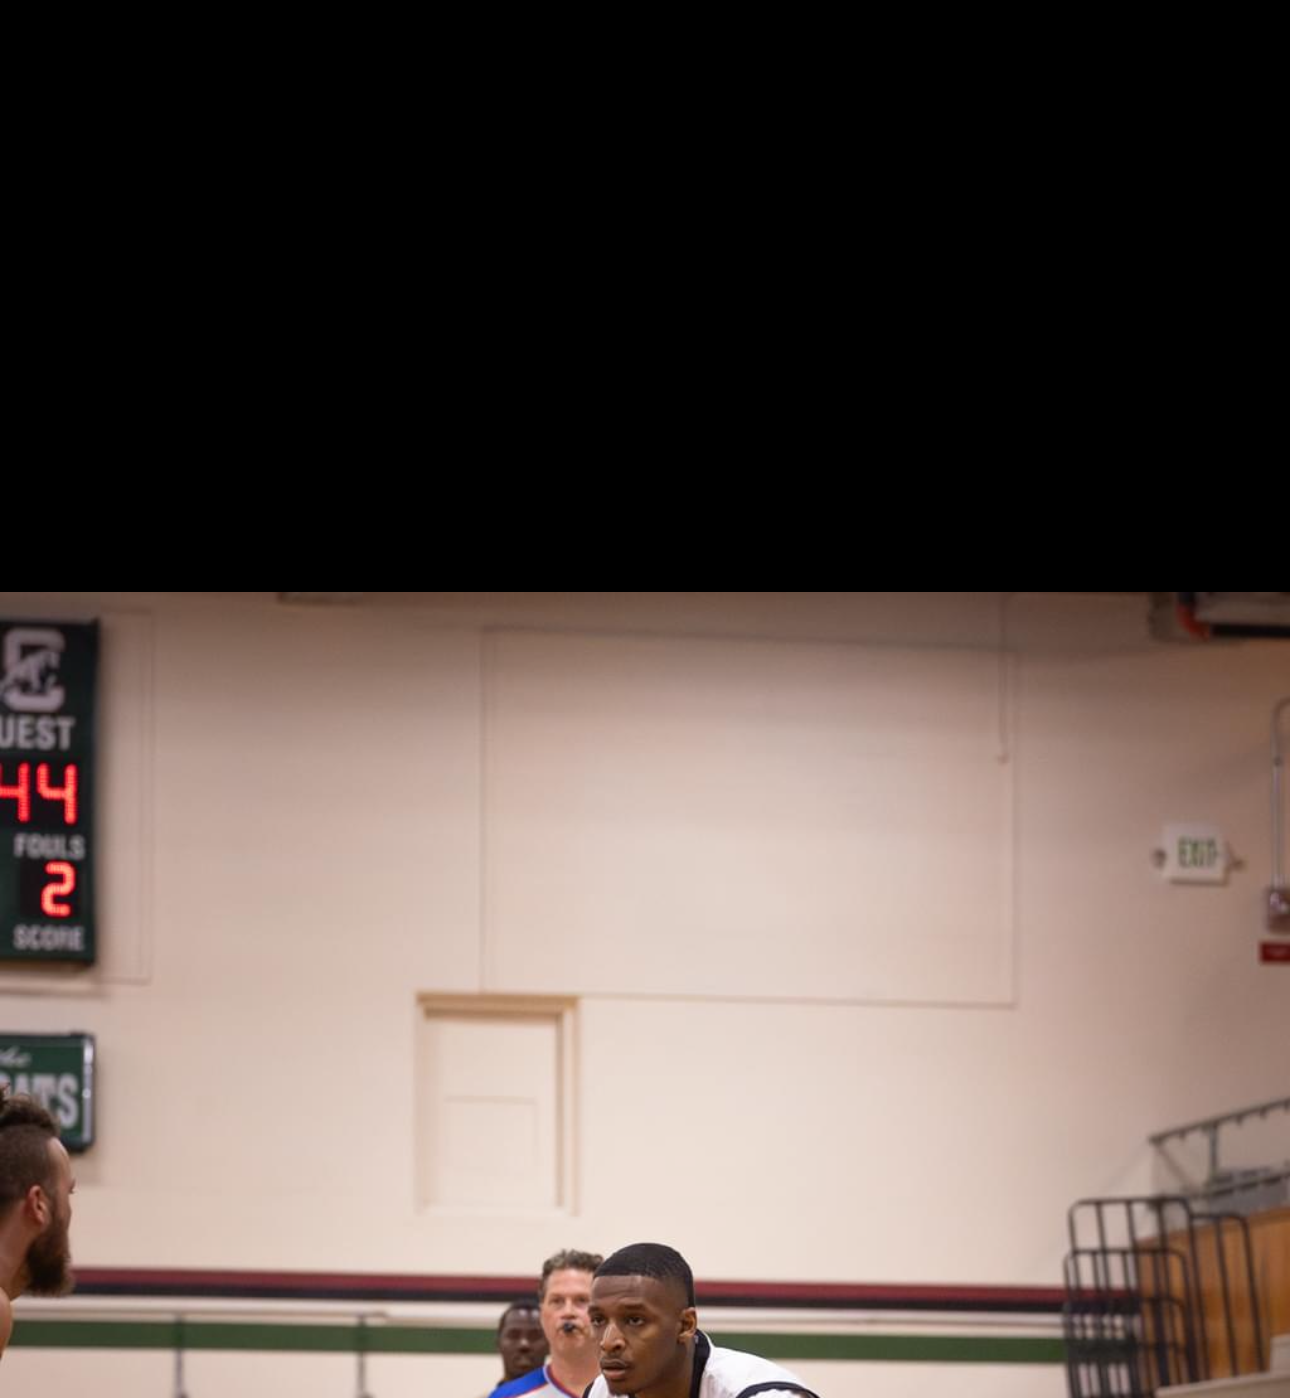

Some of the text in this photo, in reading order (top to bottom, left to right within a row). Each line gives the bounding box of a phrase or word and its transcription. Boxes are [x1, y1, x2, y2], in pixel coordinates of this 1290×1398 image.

[0, 762, 78, 825] 44
[13, 832, 86, 860] FOULS
[1178, 835, 1217, 869] EXIT
[41, 861, 76, 918] 2
[13, 924, 86, 951] SCORE
